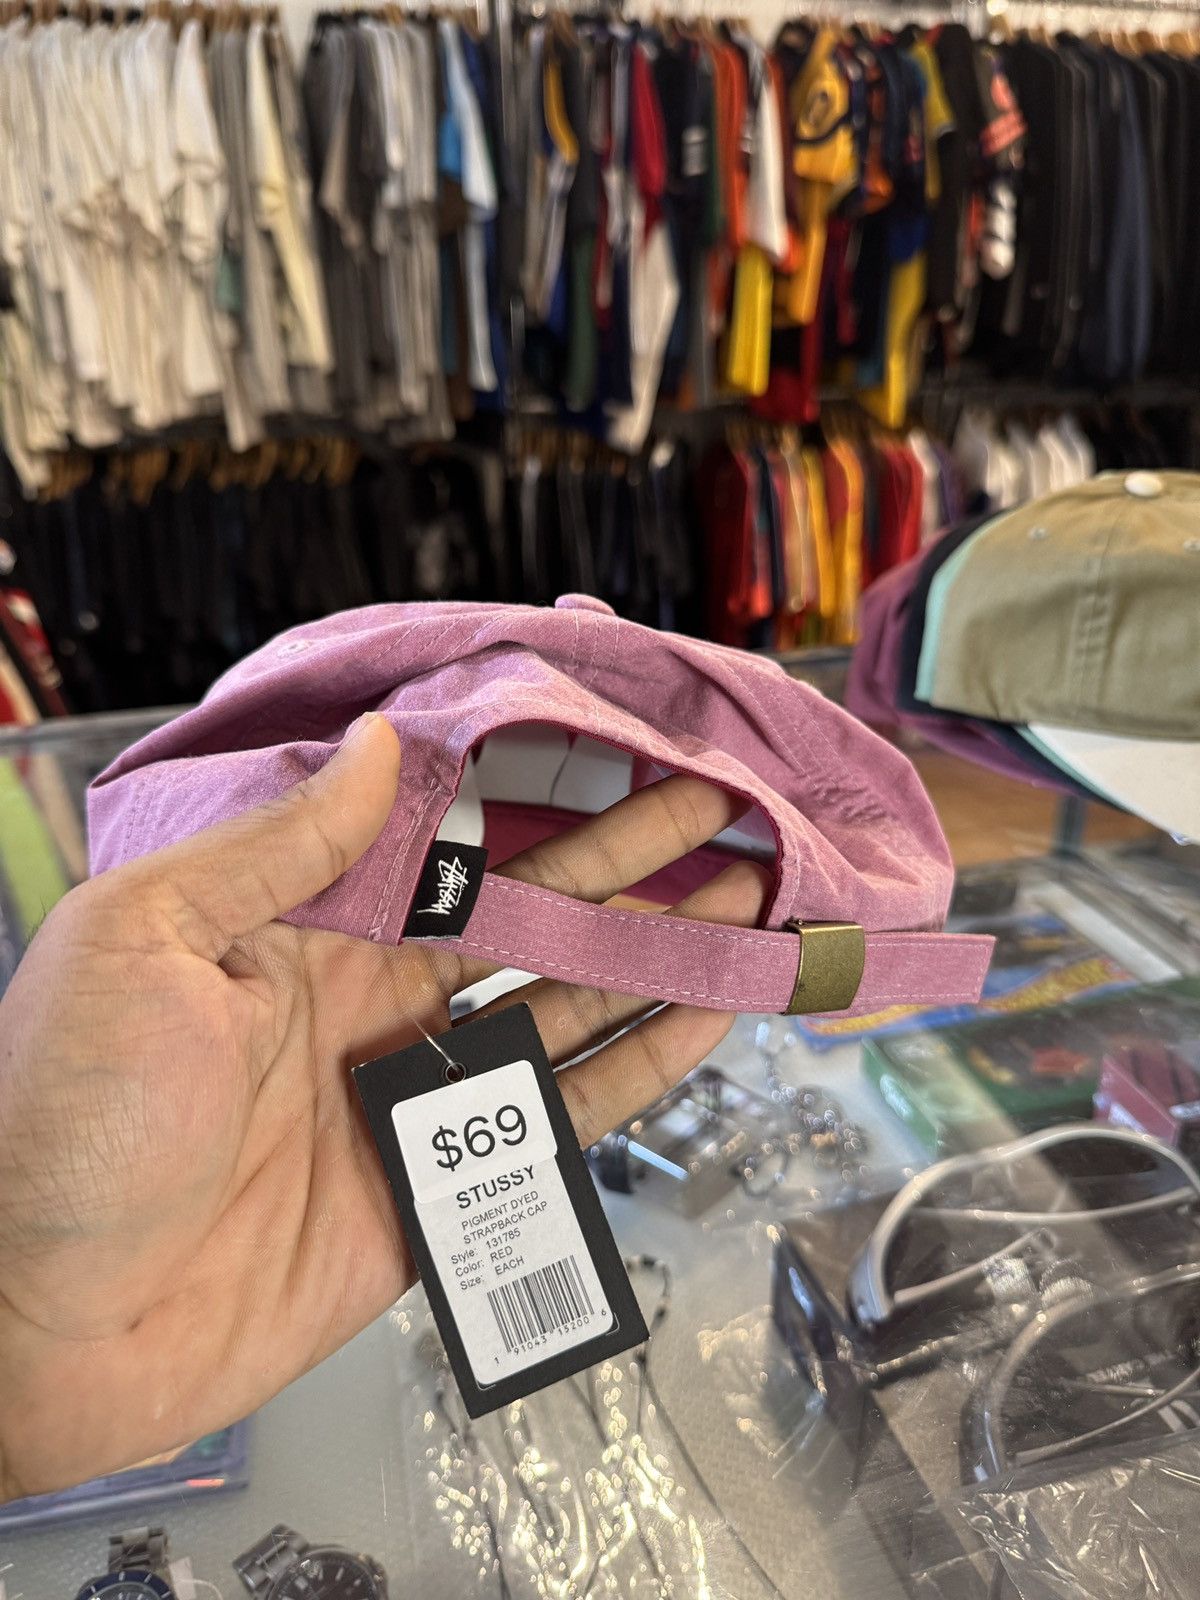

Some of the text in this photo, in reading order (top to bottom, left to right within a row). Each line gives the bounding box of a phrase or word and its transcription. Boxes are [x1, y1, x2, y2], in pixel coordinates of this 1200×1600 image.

[431, 1104, 527, 1172] $69
[456, 1164, 535, 1210] STUSSY
[461, 1190, 539, 1231] PIGMENT DYED
[463, 1200, 548, 1245] STRAPBACK CAP
[451, 1227, 521, 1265] Style: 131785
[455, 1245, 513, 1278] Color: RED
[460, 1255, 525, 1291] Size: EACH
